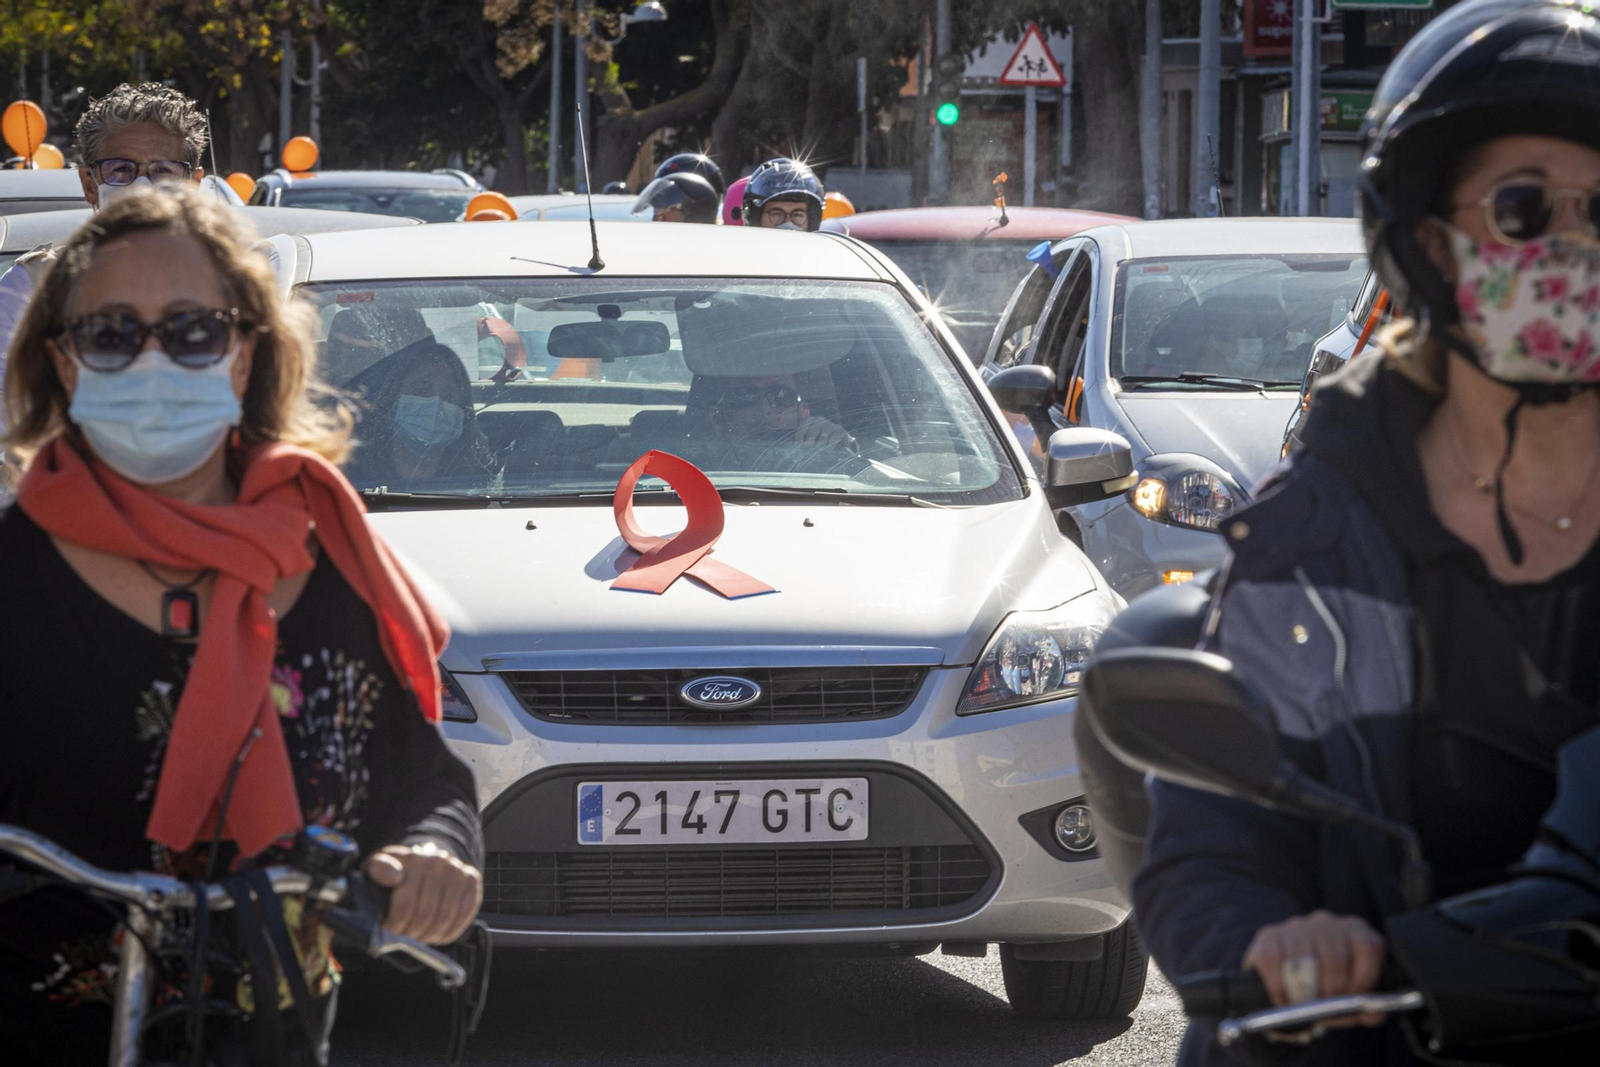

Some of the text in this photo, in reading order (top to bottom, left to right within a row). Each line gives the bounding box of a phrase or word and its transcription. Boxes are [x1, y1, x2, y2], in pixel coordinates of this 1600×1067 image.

[1258, 26, 1293, 40] supe
[700, 682, 742, 701] Ford
[615, 788, 853, 835] 2147 GTC
[587, 820, 595, 833] E
